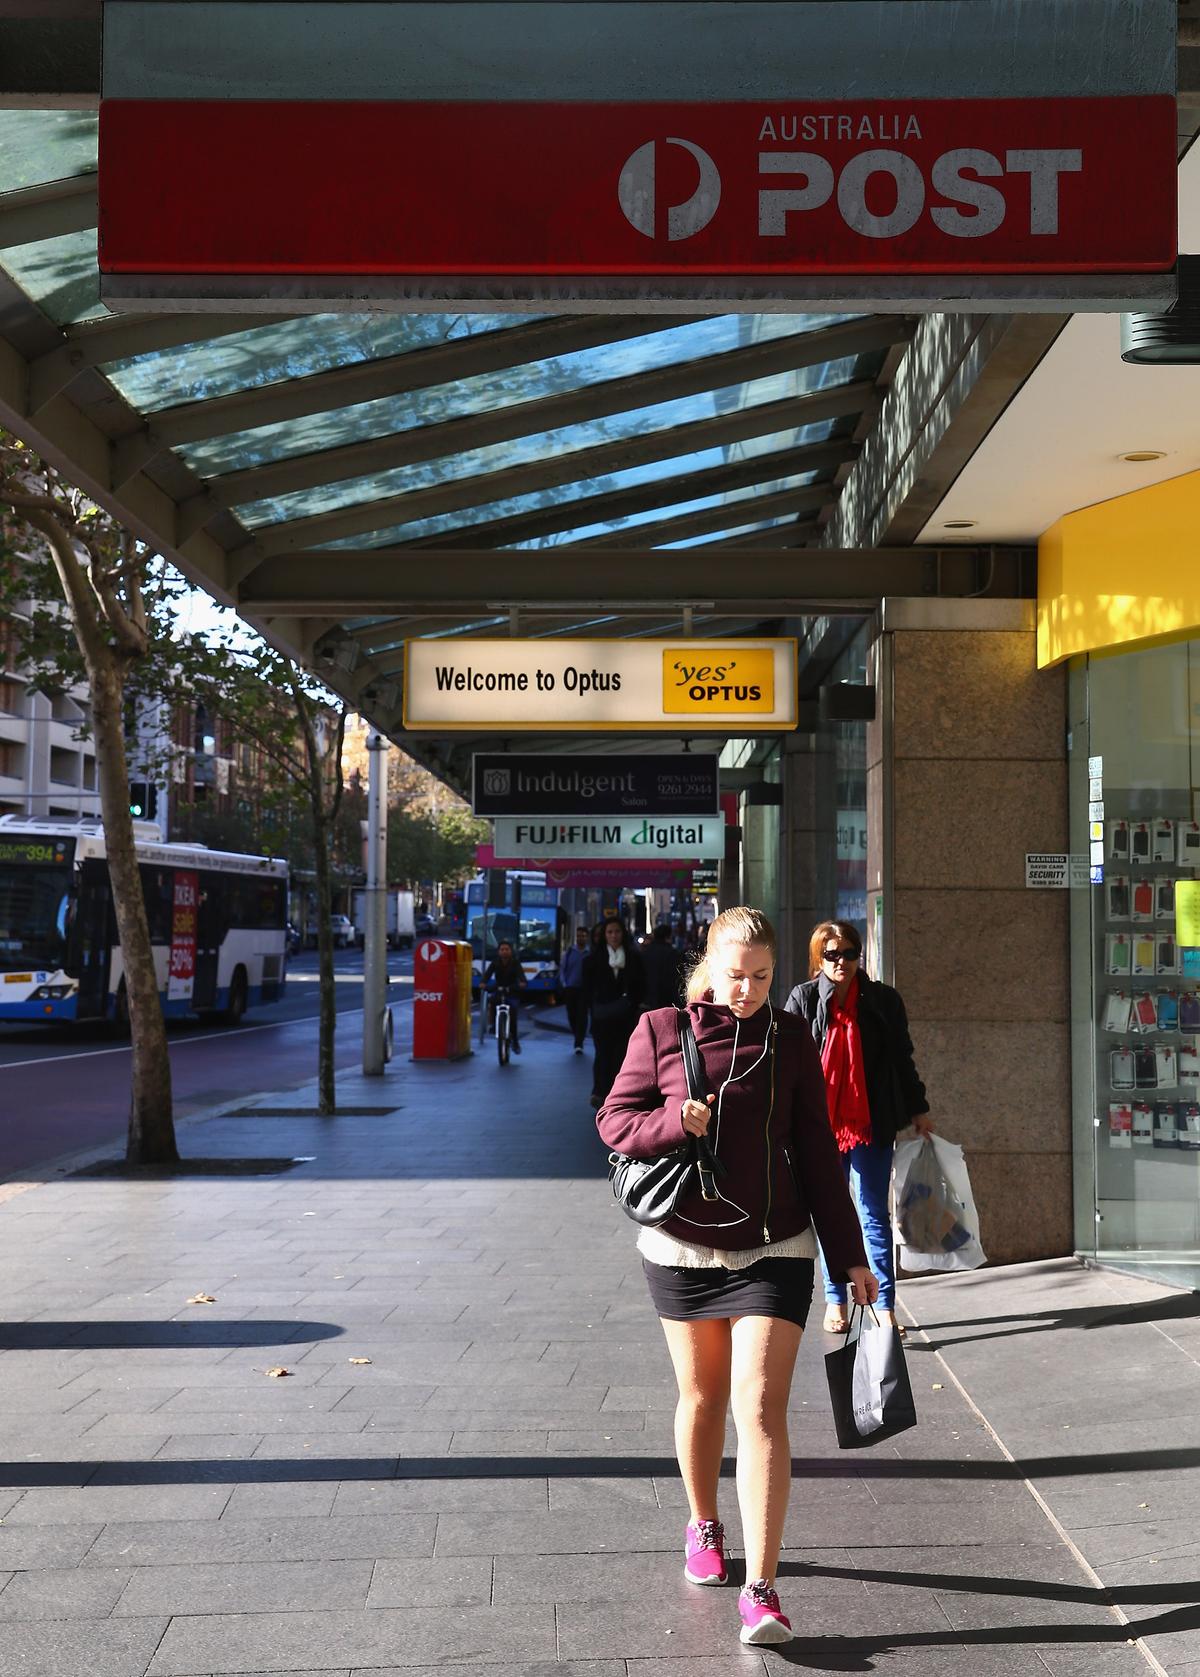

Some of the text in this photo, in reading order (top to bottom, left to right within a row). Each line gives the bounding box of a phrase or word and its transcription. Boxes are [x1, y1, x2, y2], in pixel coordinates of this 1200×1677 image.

[758, 115, 923, 141] AUSTRALIA
[758, 148, 1083, 238] POST
[435, 666, 622, 697] Welcome to Optus
[688, 685, 762, 701] OPTUS
[517, 769, 637, 798] Indulgent
[621, 796, 648, 807] Salon
[515, 820, 704, 849] FUJIFILM digital
[26, 844, 54, 862] 394
[1029, 871, 1065, 879] SECURITY
[174, 885, 195, 906] IKEA
[171, 949, 193, 972] 50%
[414, 993, 442, 1001] POST
